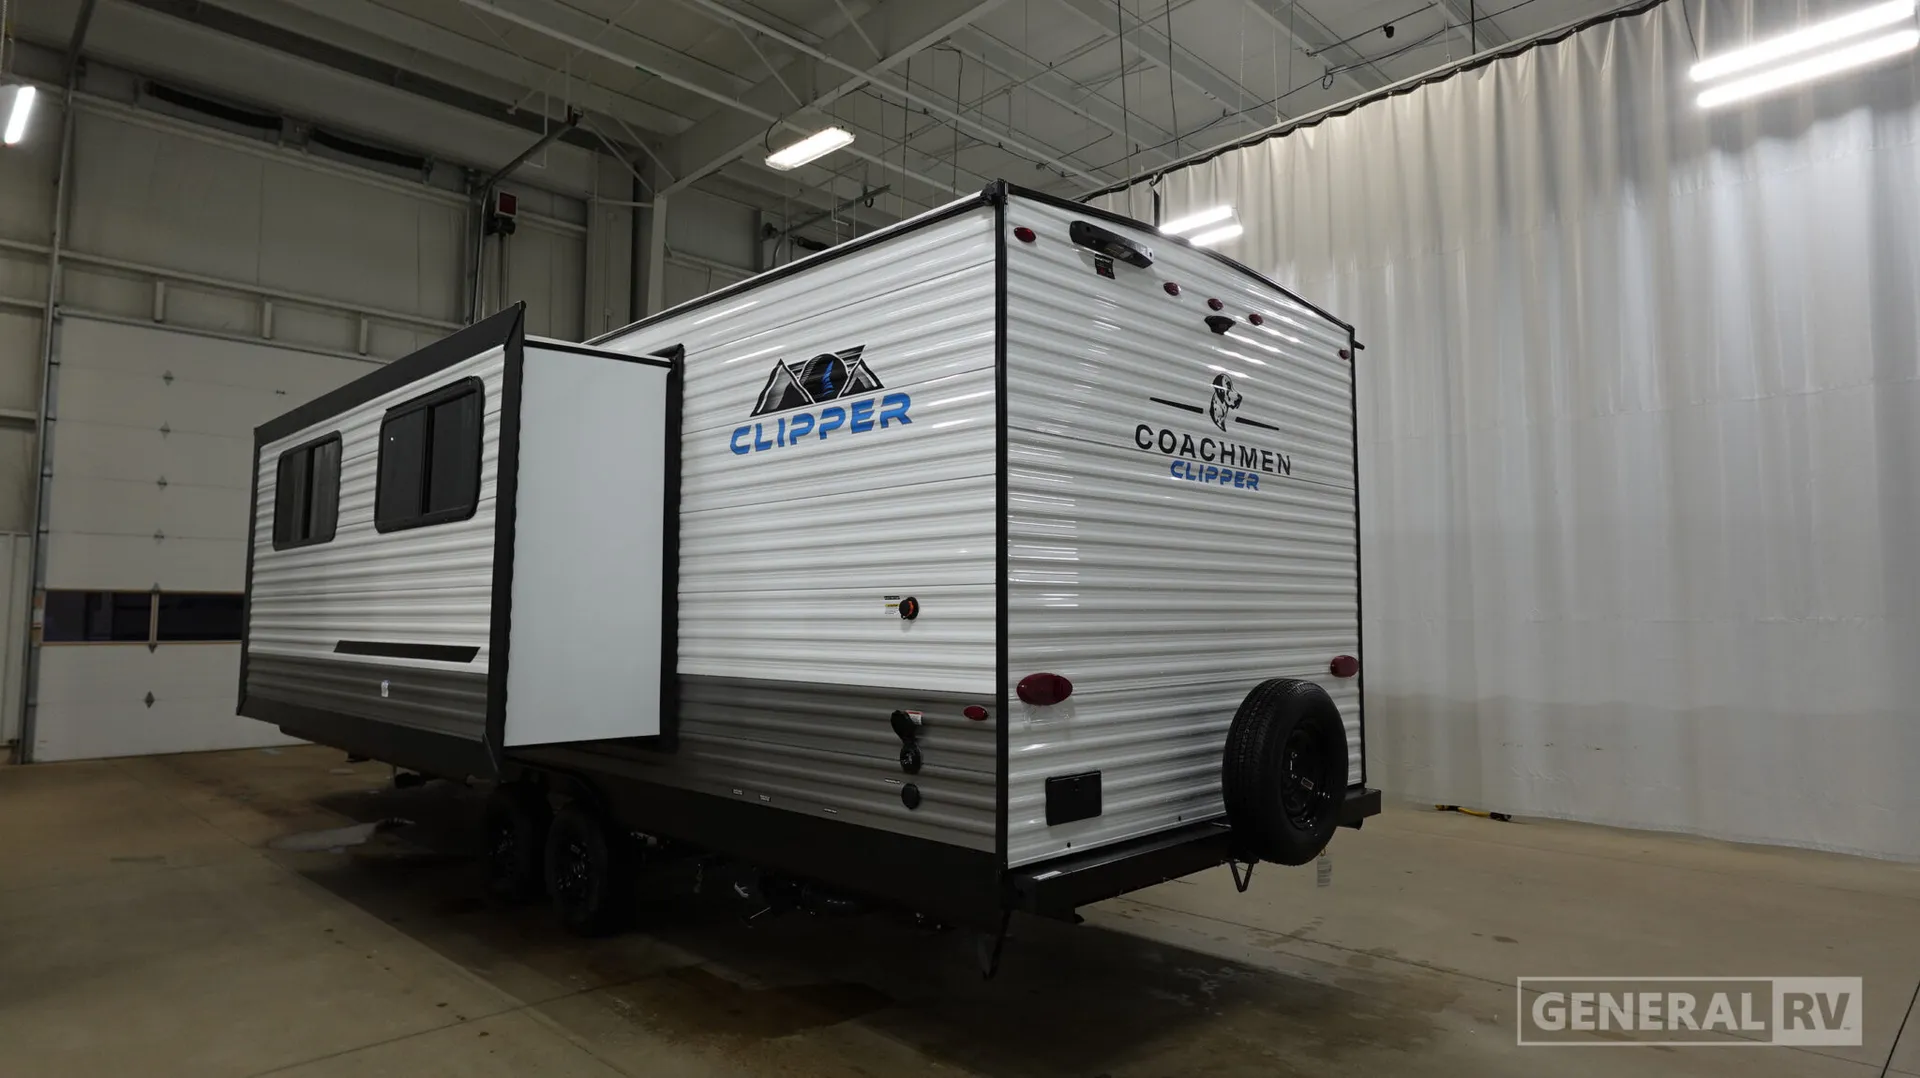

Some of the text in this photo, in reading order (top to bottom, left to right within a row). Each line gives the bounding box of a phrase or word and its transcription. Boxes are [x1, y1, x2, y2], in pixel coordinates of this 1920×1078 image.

[730, 392, 913, 455] CLIPPER
[1135, 424, 1291, 475] COACHMEN
[1170, 460, 1260, 491] CLIPPER
